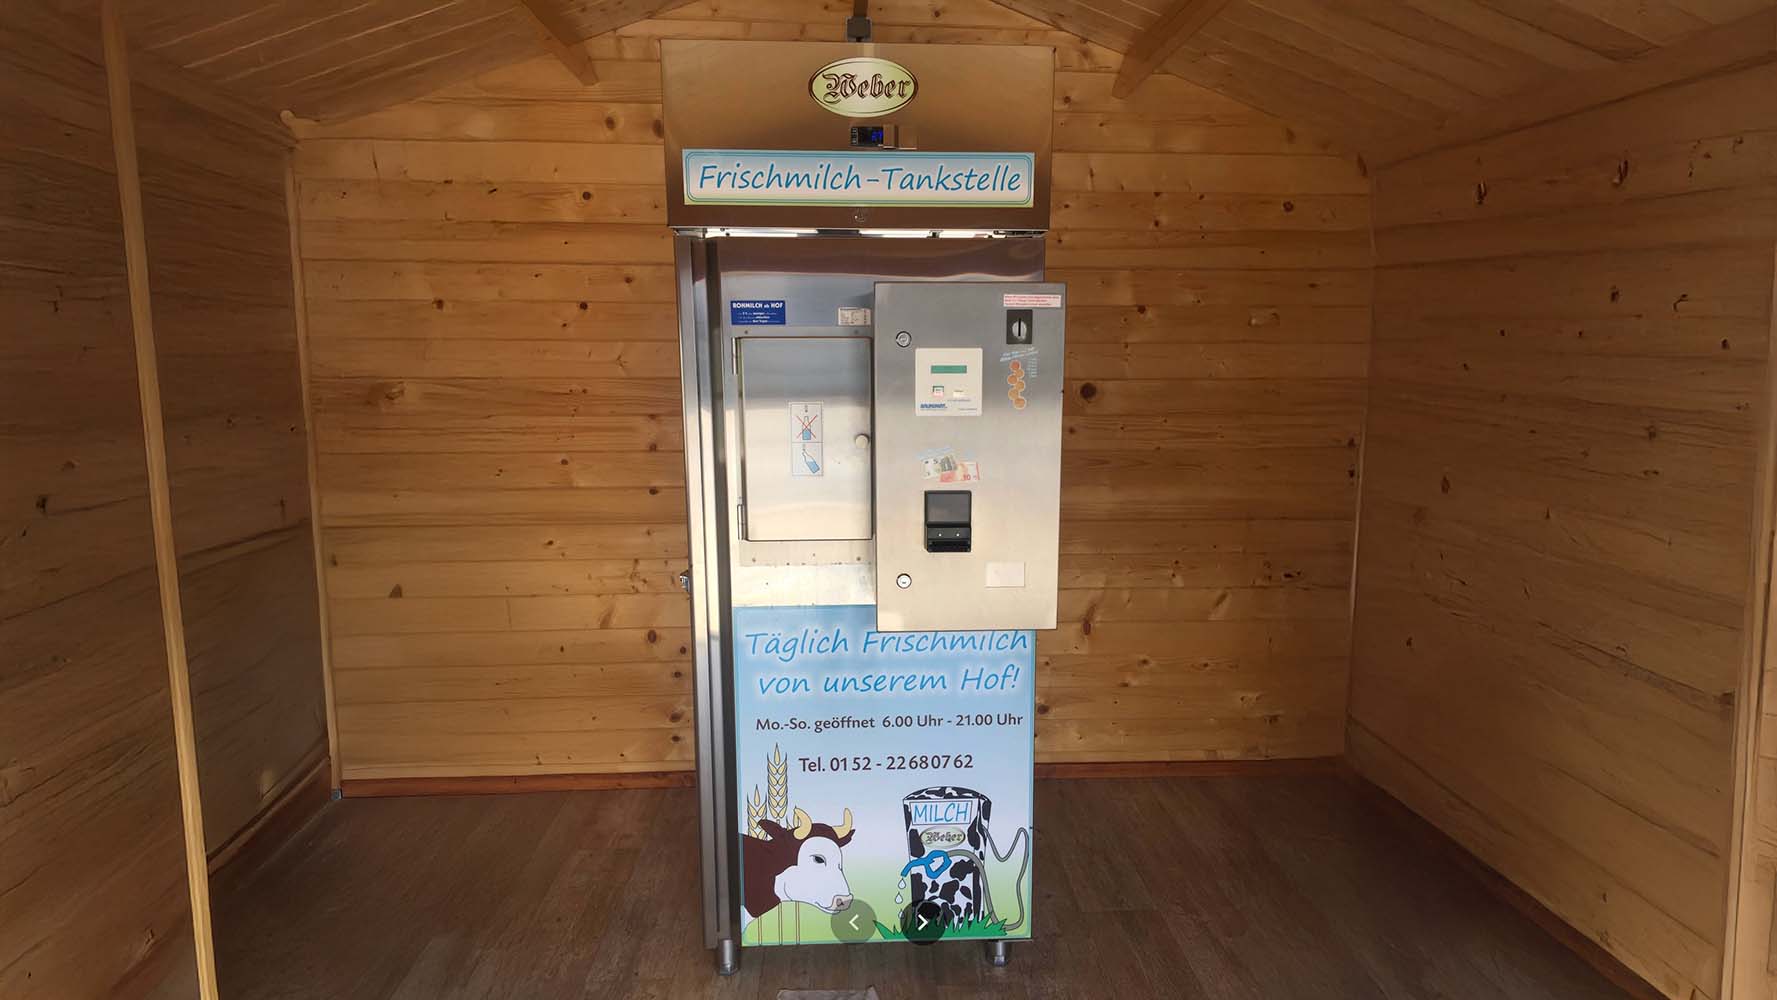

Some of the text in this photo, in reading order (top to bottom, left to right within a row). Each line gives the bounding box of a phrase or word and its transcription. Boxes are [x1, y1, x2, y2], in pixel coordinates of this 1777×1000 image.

[823, 72, 911, 104] Weber
[699, 162, 1021, 192] Frischmilch-Tankstelle
[746, 629, 1028, 662] Täglich Frischmilch
[759, 664, 1020, 695] von unserem Hof!
[756, 717, 811, 731] Mo.-So.
[814, 716, 875, 733] geöffnet
[882, 715, 913, 729] 6.00
[917, 714, 943, 728] Uhr
[956, 714, 993, 727] 21.00
[997, 713, 1023, 727] Uhr
[799, 757, 826, 772] Tel.
[830, 756, 872, 771] 0152
[886, 754, 974, 771] 22680762
[914, 803, 969, 822] MILCH
[926, 832, 962, 844] Weber
